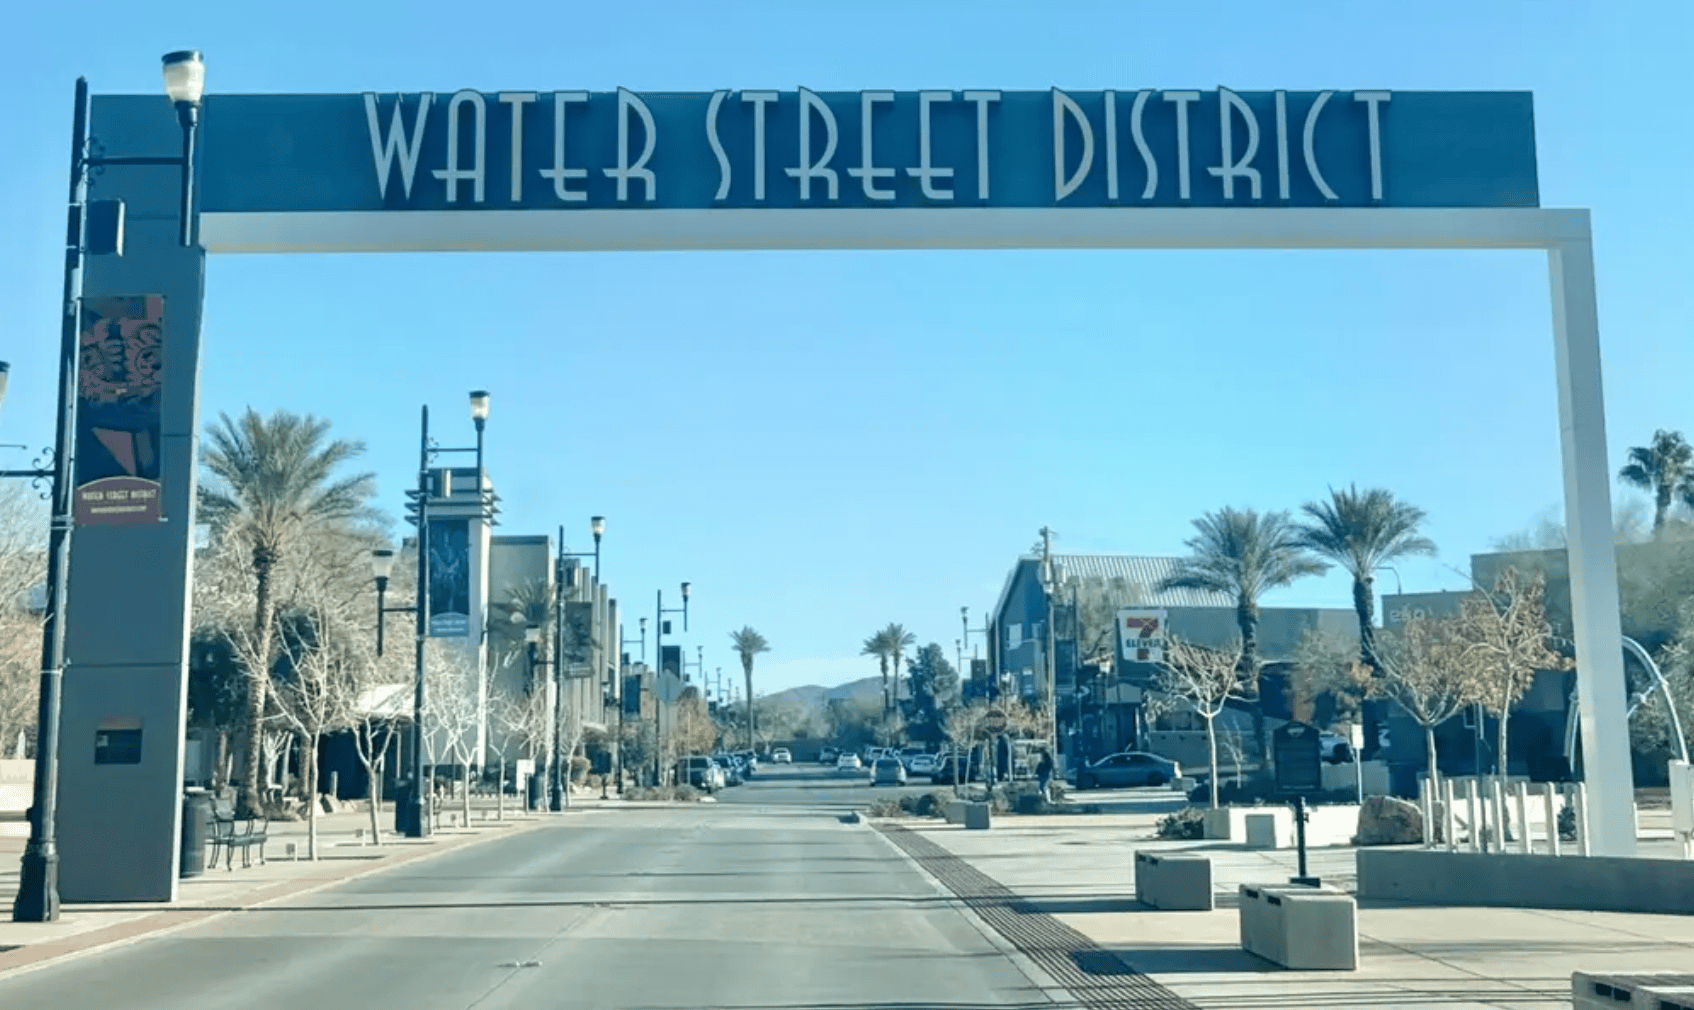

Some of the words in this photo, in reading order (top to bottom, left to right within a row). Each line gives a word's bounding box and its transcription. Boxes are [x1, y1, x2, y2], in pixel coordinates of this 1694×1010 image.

[363, 86, 657, 202] WATER
[704, 86, 1003, 201] STREET
[1051, 85, 1391, 201] DISTRICT
